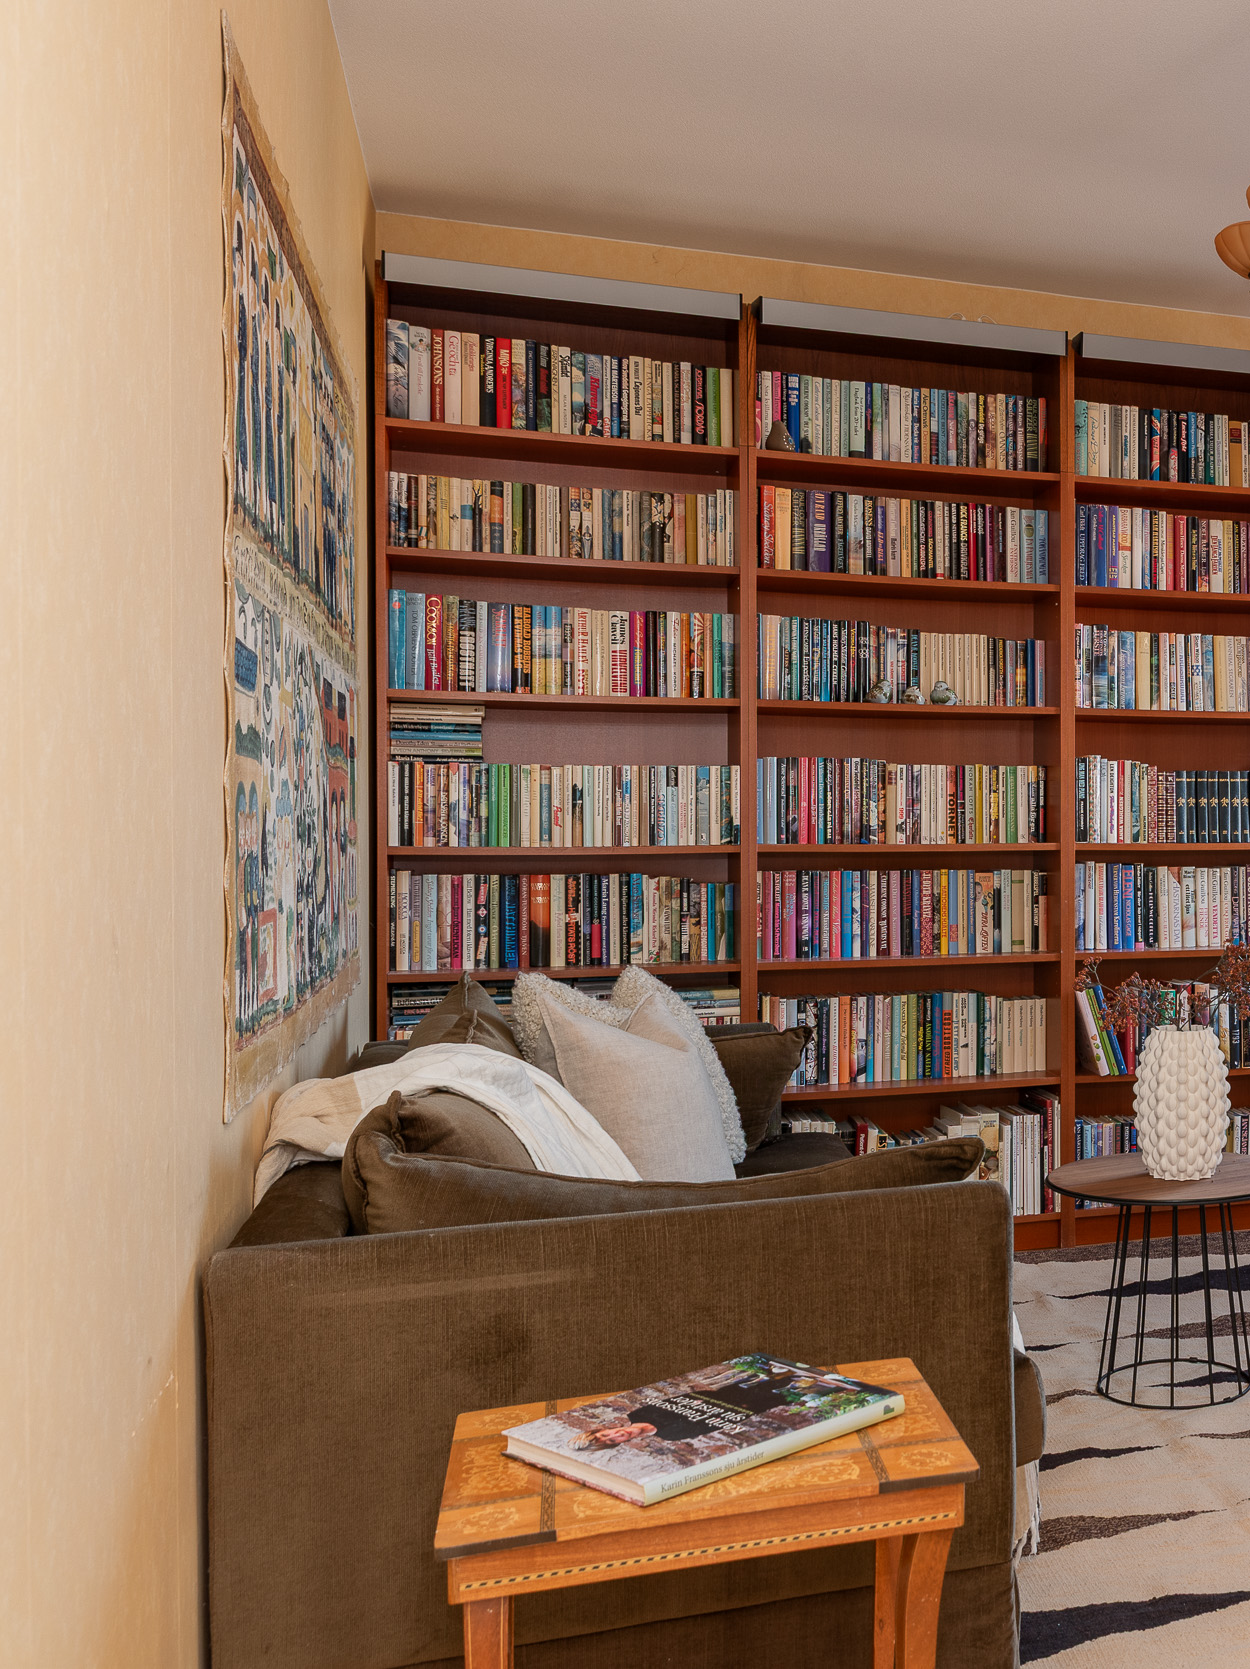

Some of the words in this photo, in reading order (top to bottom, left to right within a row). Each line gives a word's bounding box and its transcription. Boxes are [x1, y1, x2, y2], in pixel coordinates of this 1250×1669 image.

[485, 338, 495, 364] VIRGINIA
[499, 350, 510, 368] MIKO
[485, 364, 495, 393] ANDREWS
[633, 381, 643, 405] Lejonens
[762, 501, 773, 529] Sidney
[762, 532, 773, 564] Sheldon
[426, 597, 441, 645] COOKSON
[578, 610, 589, 637] ARTHUR
[459, 631, 475, 688] FROSTNATT
[578, 639, 589, 664] HAILEY
[1122, 870, 1133, 899] ELENI
[641, 1398, 708, 1422] Franssons
[671, 1396, 724, 1416] årstider
[721, 1411, 746, 1422] sju
[705, 1417, 746, 1435] Karin
[661, 1479, 683, 1493] Karin
[684, 1467, 722, 1485] Franssons
[724, 1461, 735, 1471] sju
[736, 1451, 765, 1466] årstider
